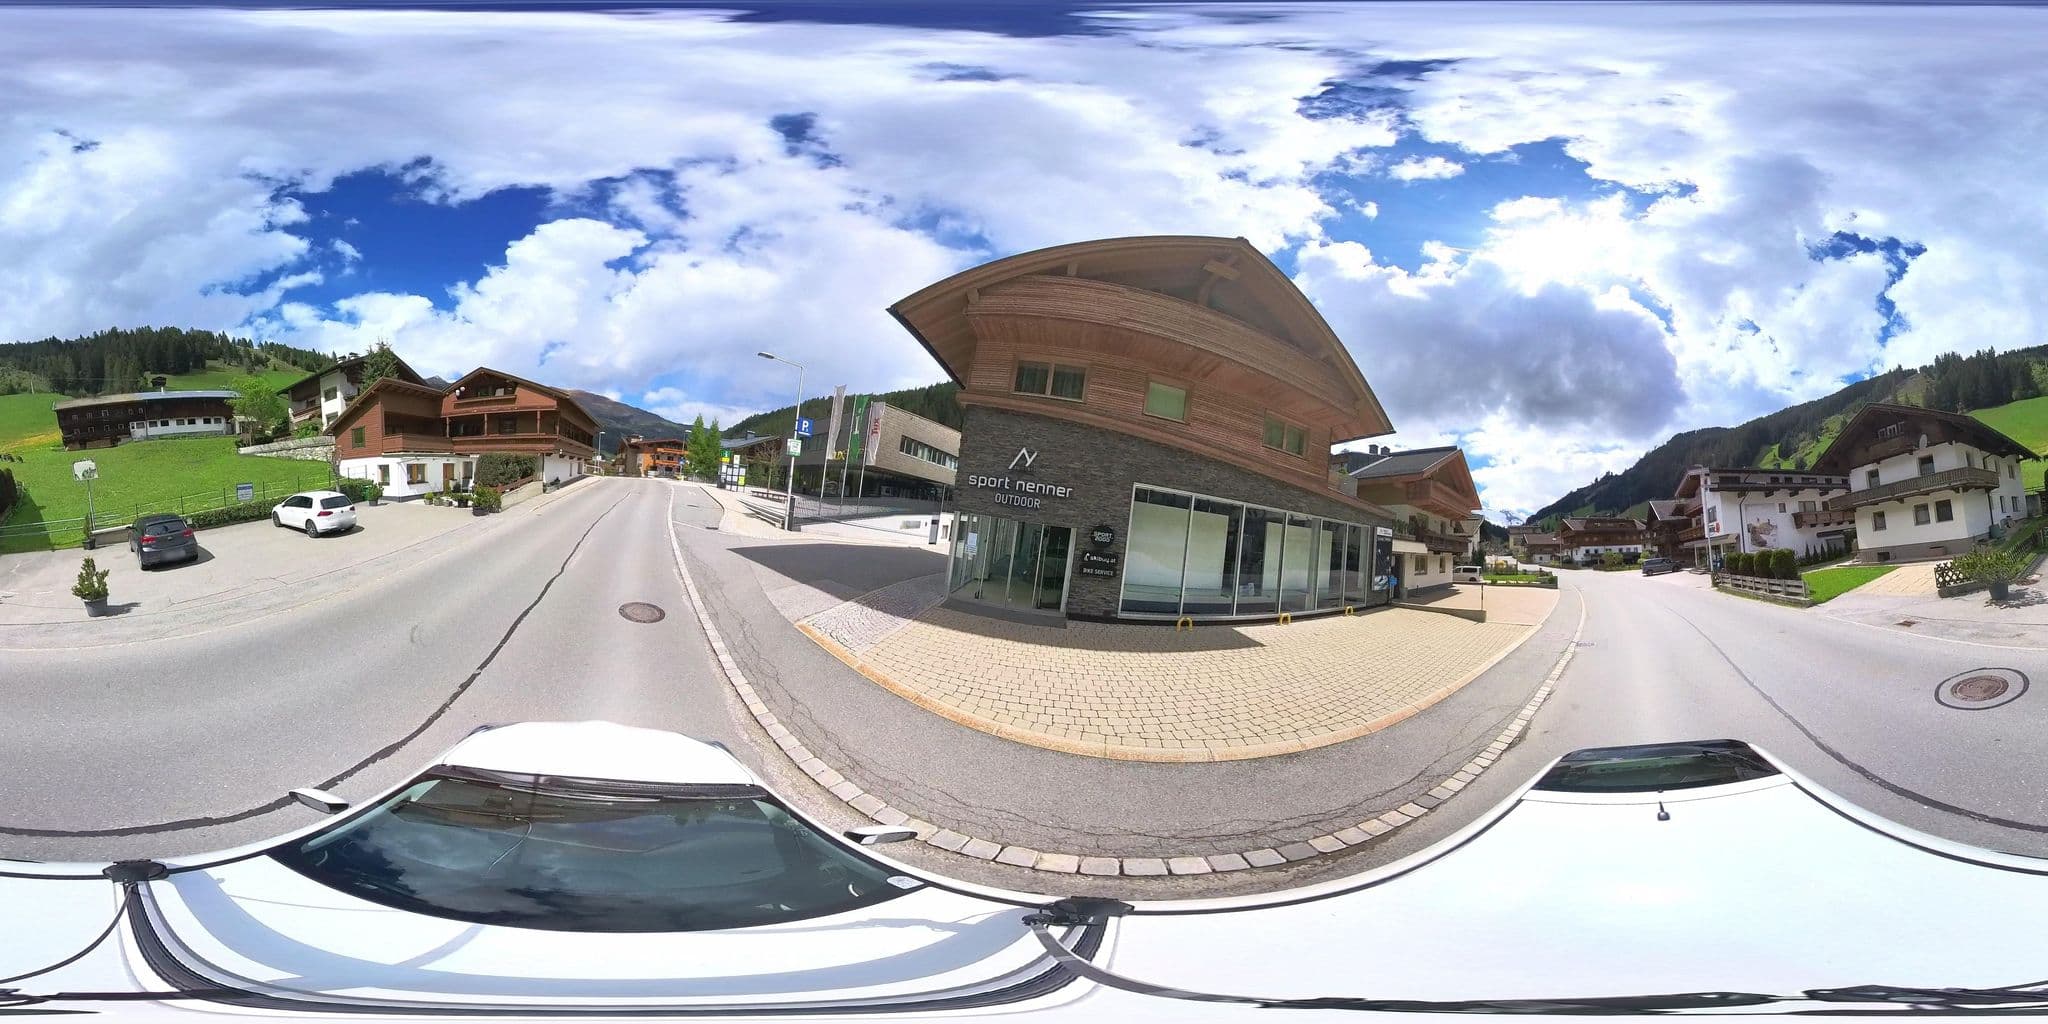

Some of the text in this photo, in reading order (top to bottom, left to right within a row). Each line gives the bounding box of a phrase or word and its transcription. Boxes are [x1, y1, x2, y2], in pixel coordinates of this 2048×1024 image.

[801, 420, 809, 432] P
[968, 475, 1073, 498] sport nenner
[994, 493, 1041, 509] OUTDOOR
